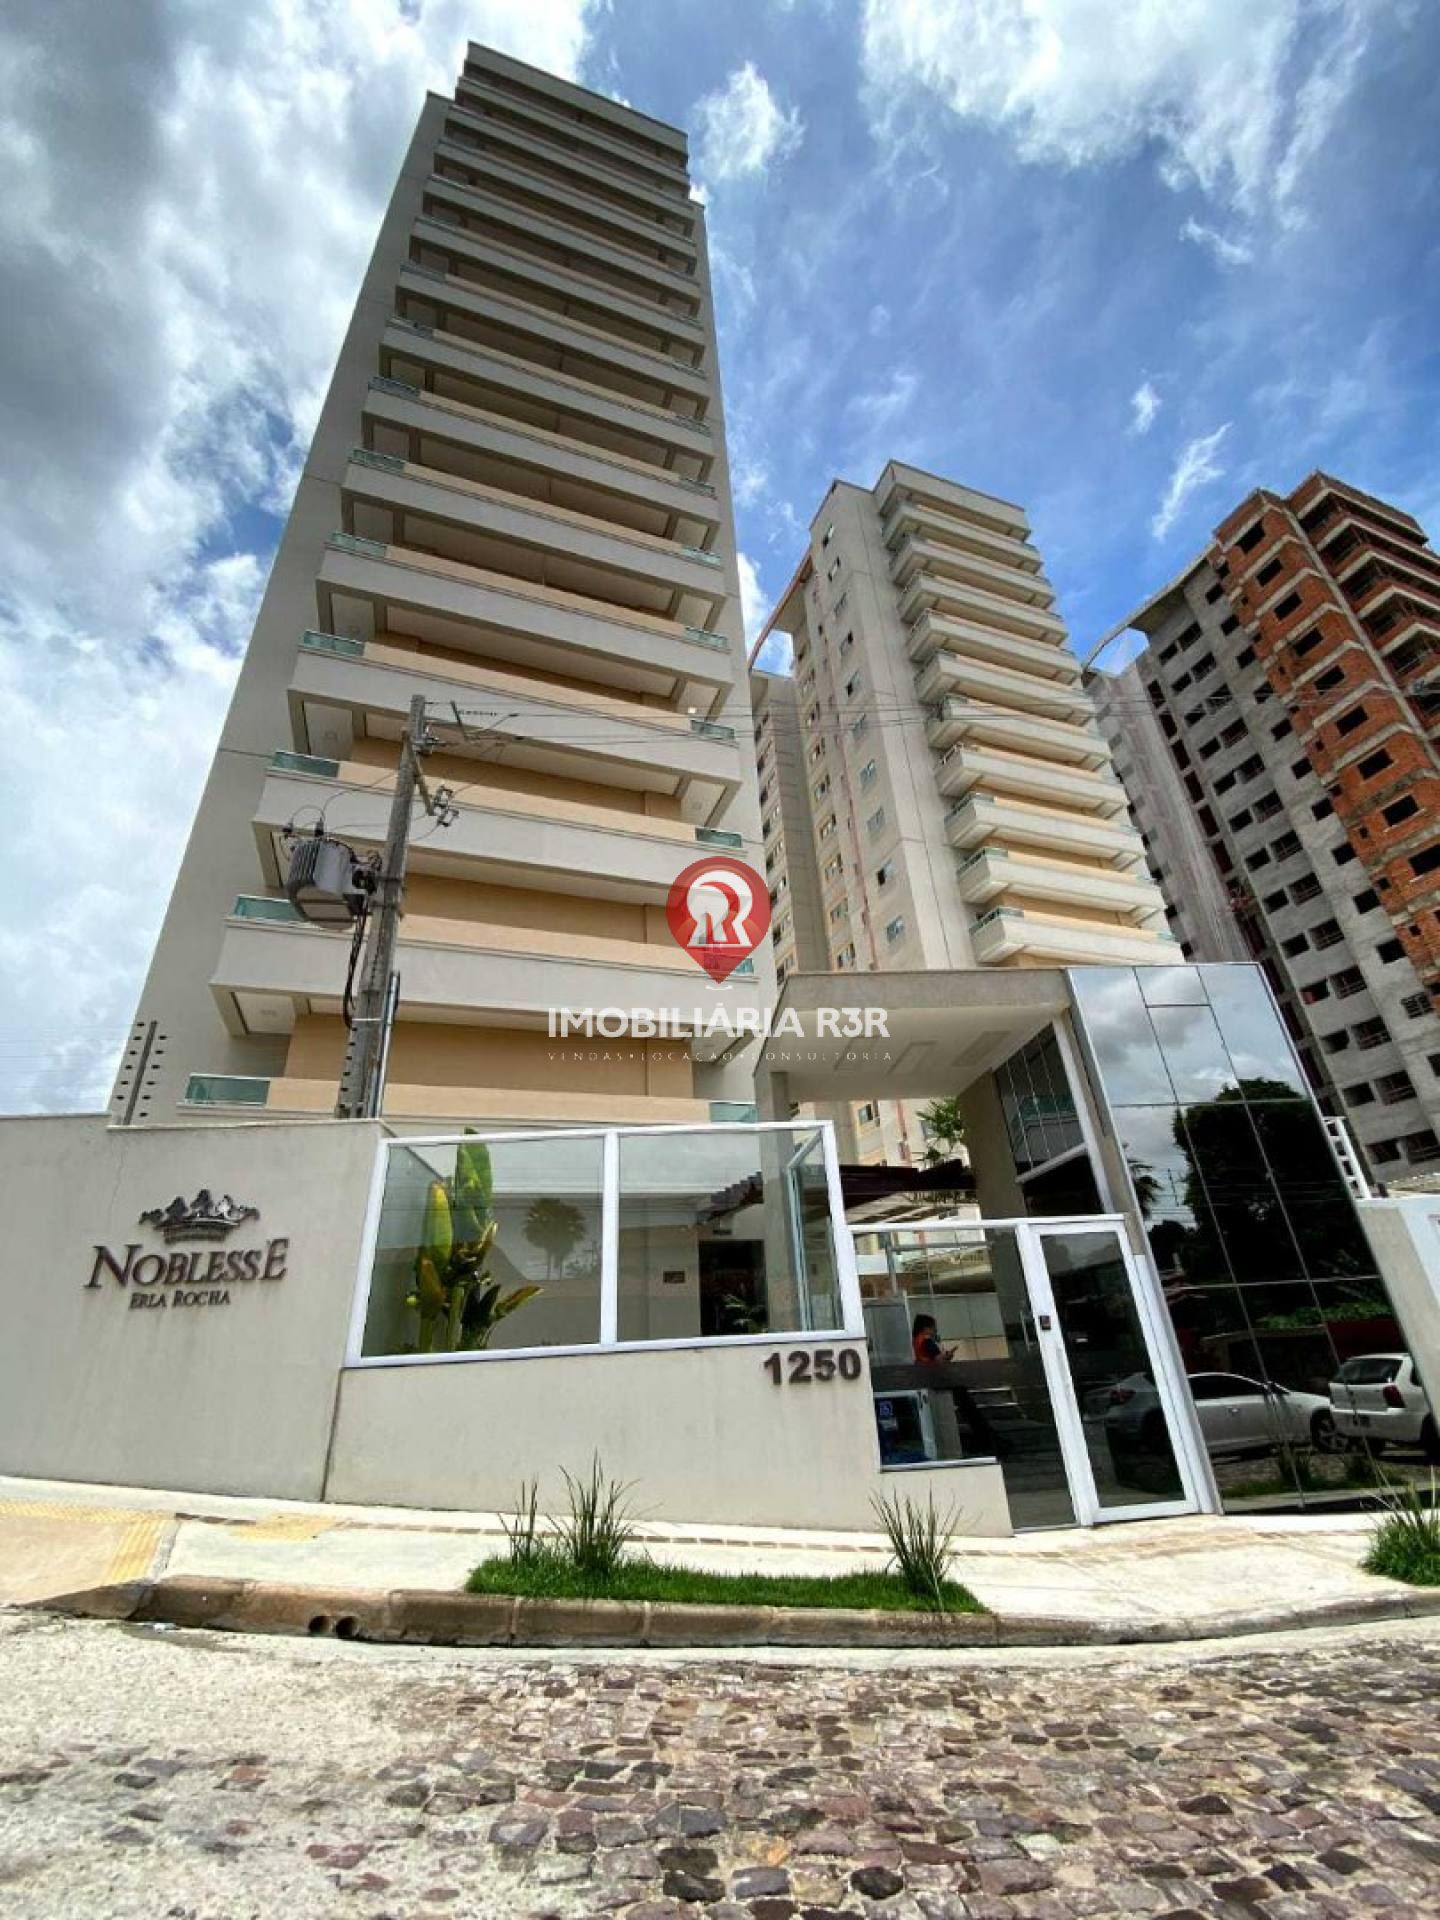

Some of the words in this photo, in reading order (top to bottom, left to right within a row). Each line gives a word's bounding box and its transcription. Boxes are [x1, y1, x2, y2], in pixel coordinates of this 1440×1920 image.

[82, 1238, 289, 1290] NOBLESSE
[171, 1290, 231, 1308] ROCHA
[763, 1348, 862, 1386] 1250
